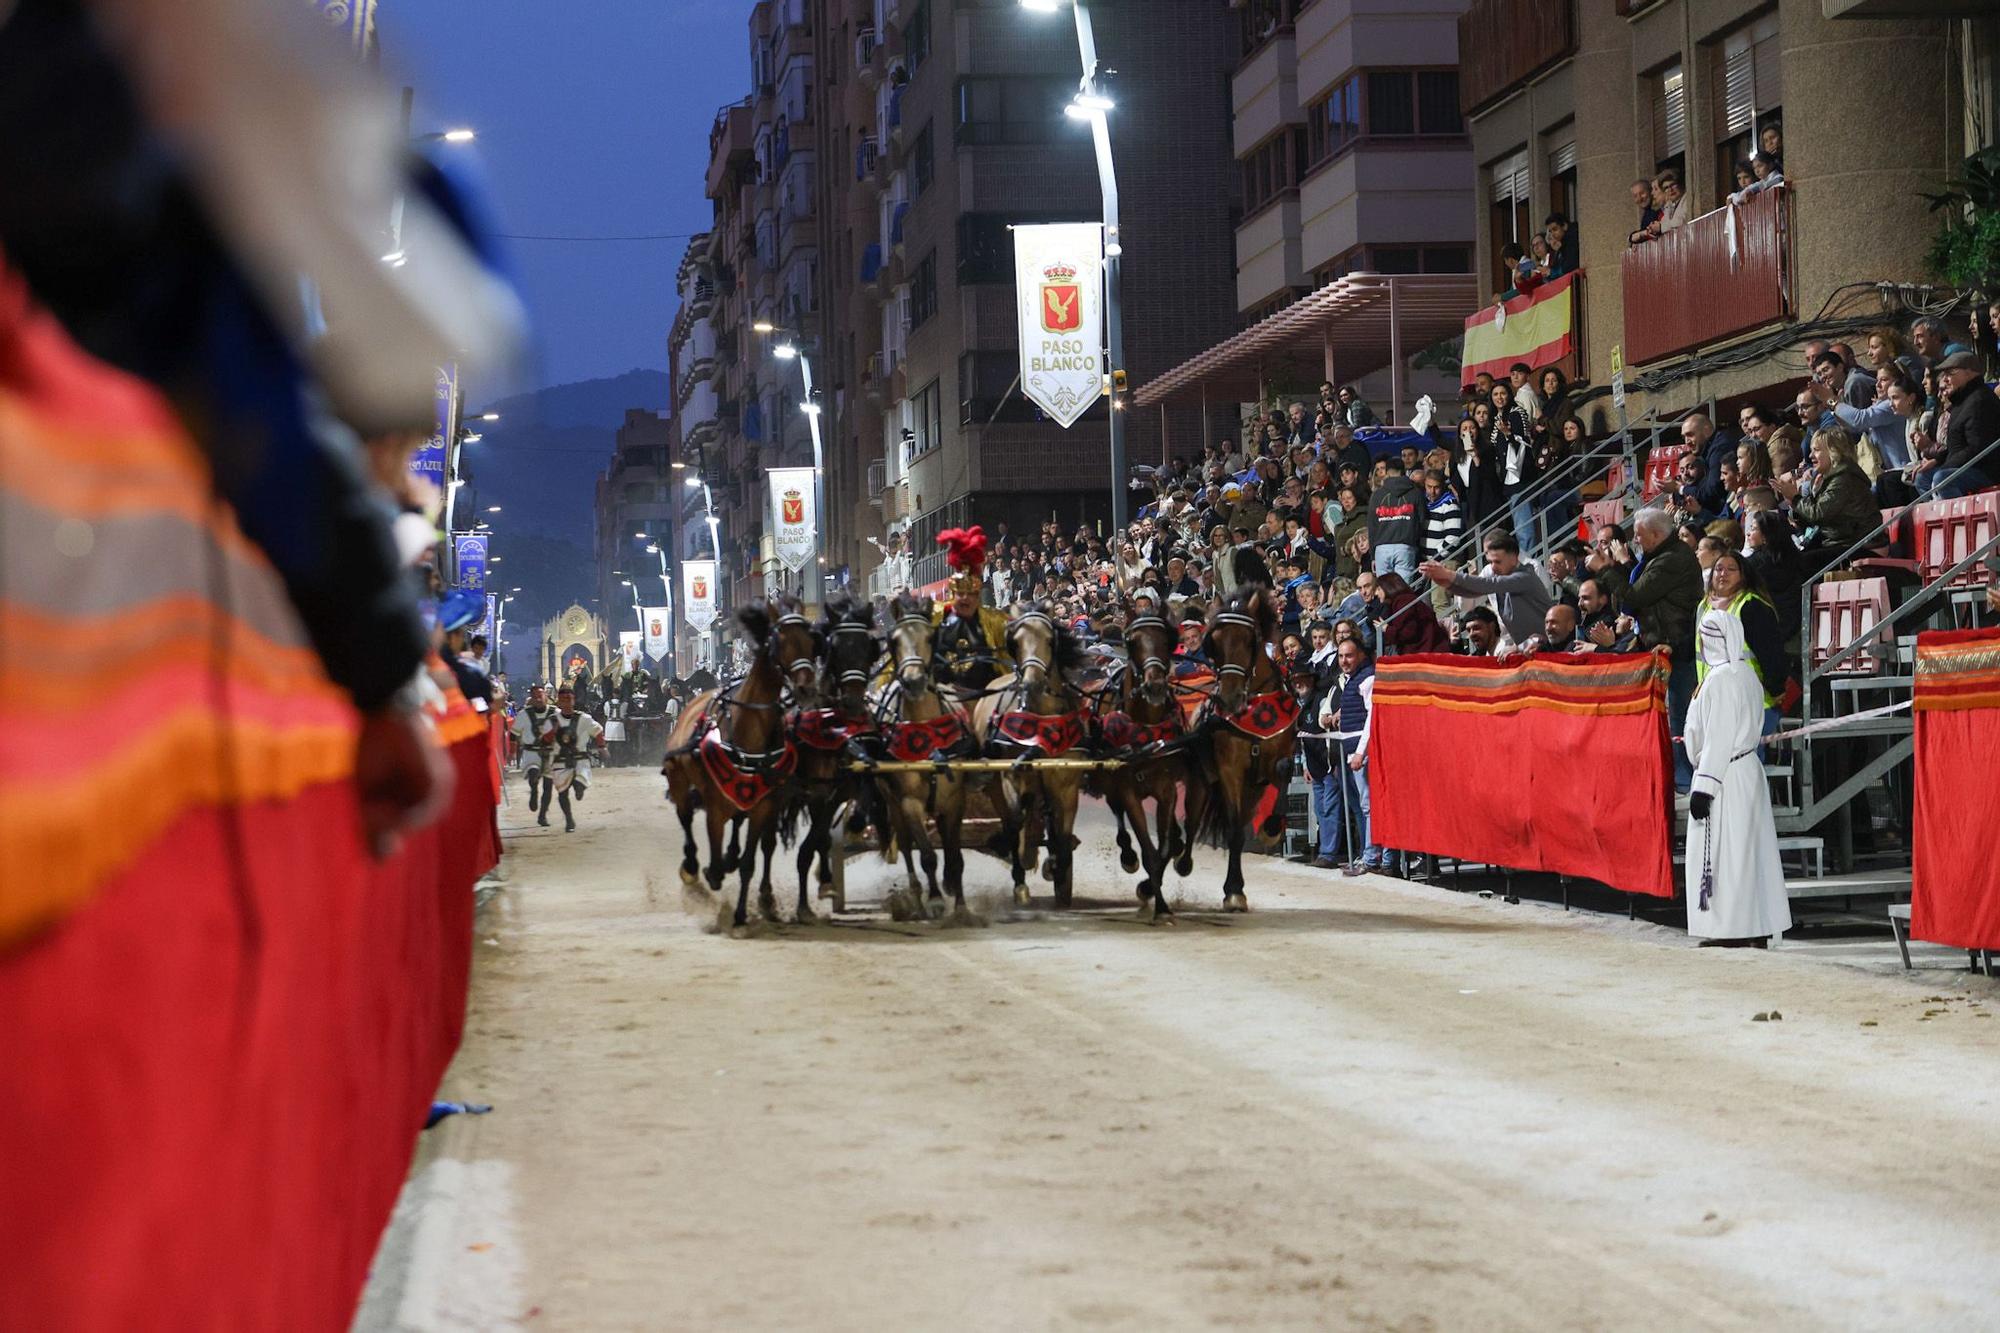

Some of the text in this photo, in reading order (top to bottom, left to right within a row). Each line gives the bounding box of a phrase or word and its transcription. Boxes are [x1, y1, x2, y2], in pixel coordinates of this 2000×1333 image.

[1041, 339, 1083, 356] PASO
[1031, 356, 1095, 372] BLANCO
[423, 461, 443, 472] AZUL
[783, 527, 805, 536] PASO
[777, 536, 811, 545] BLANCO
